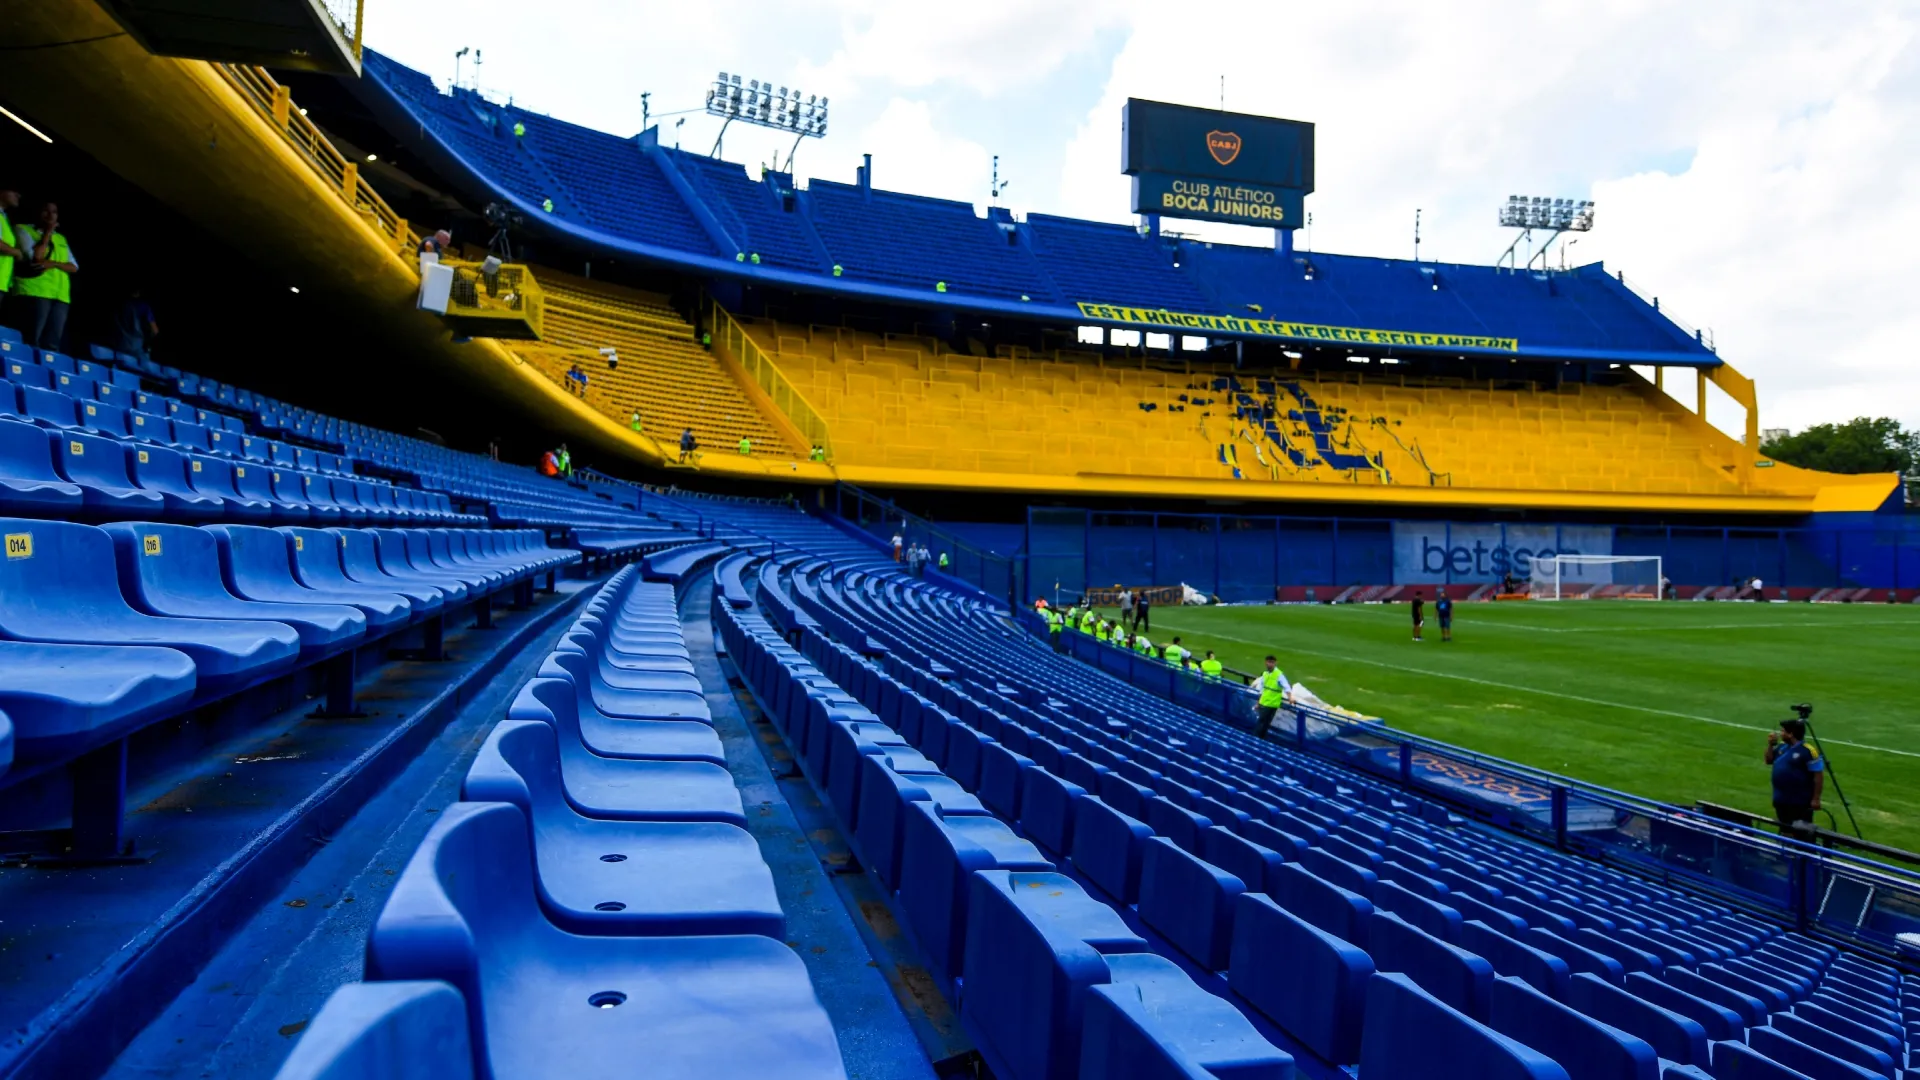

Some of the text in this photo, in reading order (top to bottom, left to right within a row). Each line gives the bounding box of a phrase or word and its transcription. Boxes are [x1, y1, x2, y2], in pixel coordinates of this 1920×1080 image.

[1211, 139, 1237, 150] CABJ
[1172, 180, 1275, 204] CLUB ATLÉTICO
[1162, 193, 1284, 221] BOCA JUNIORS
[1082, 305, 1142, 321] ESTA
[1144, 311, 1256, 333] HINCHADA
[1258, 322, 1287, 335] SE
[1288, 325, 1373, 342] MERECE
[1375, 333, 1416, 345] SER
[9, 538, 27, 553] 014
[145, 539, 157, 551] 016
[1422, 536, 1583, 576] betsson
